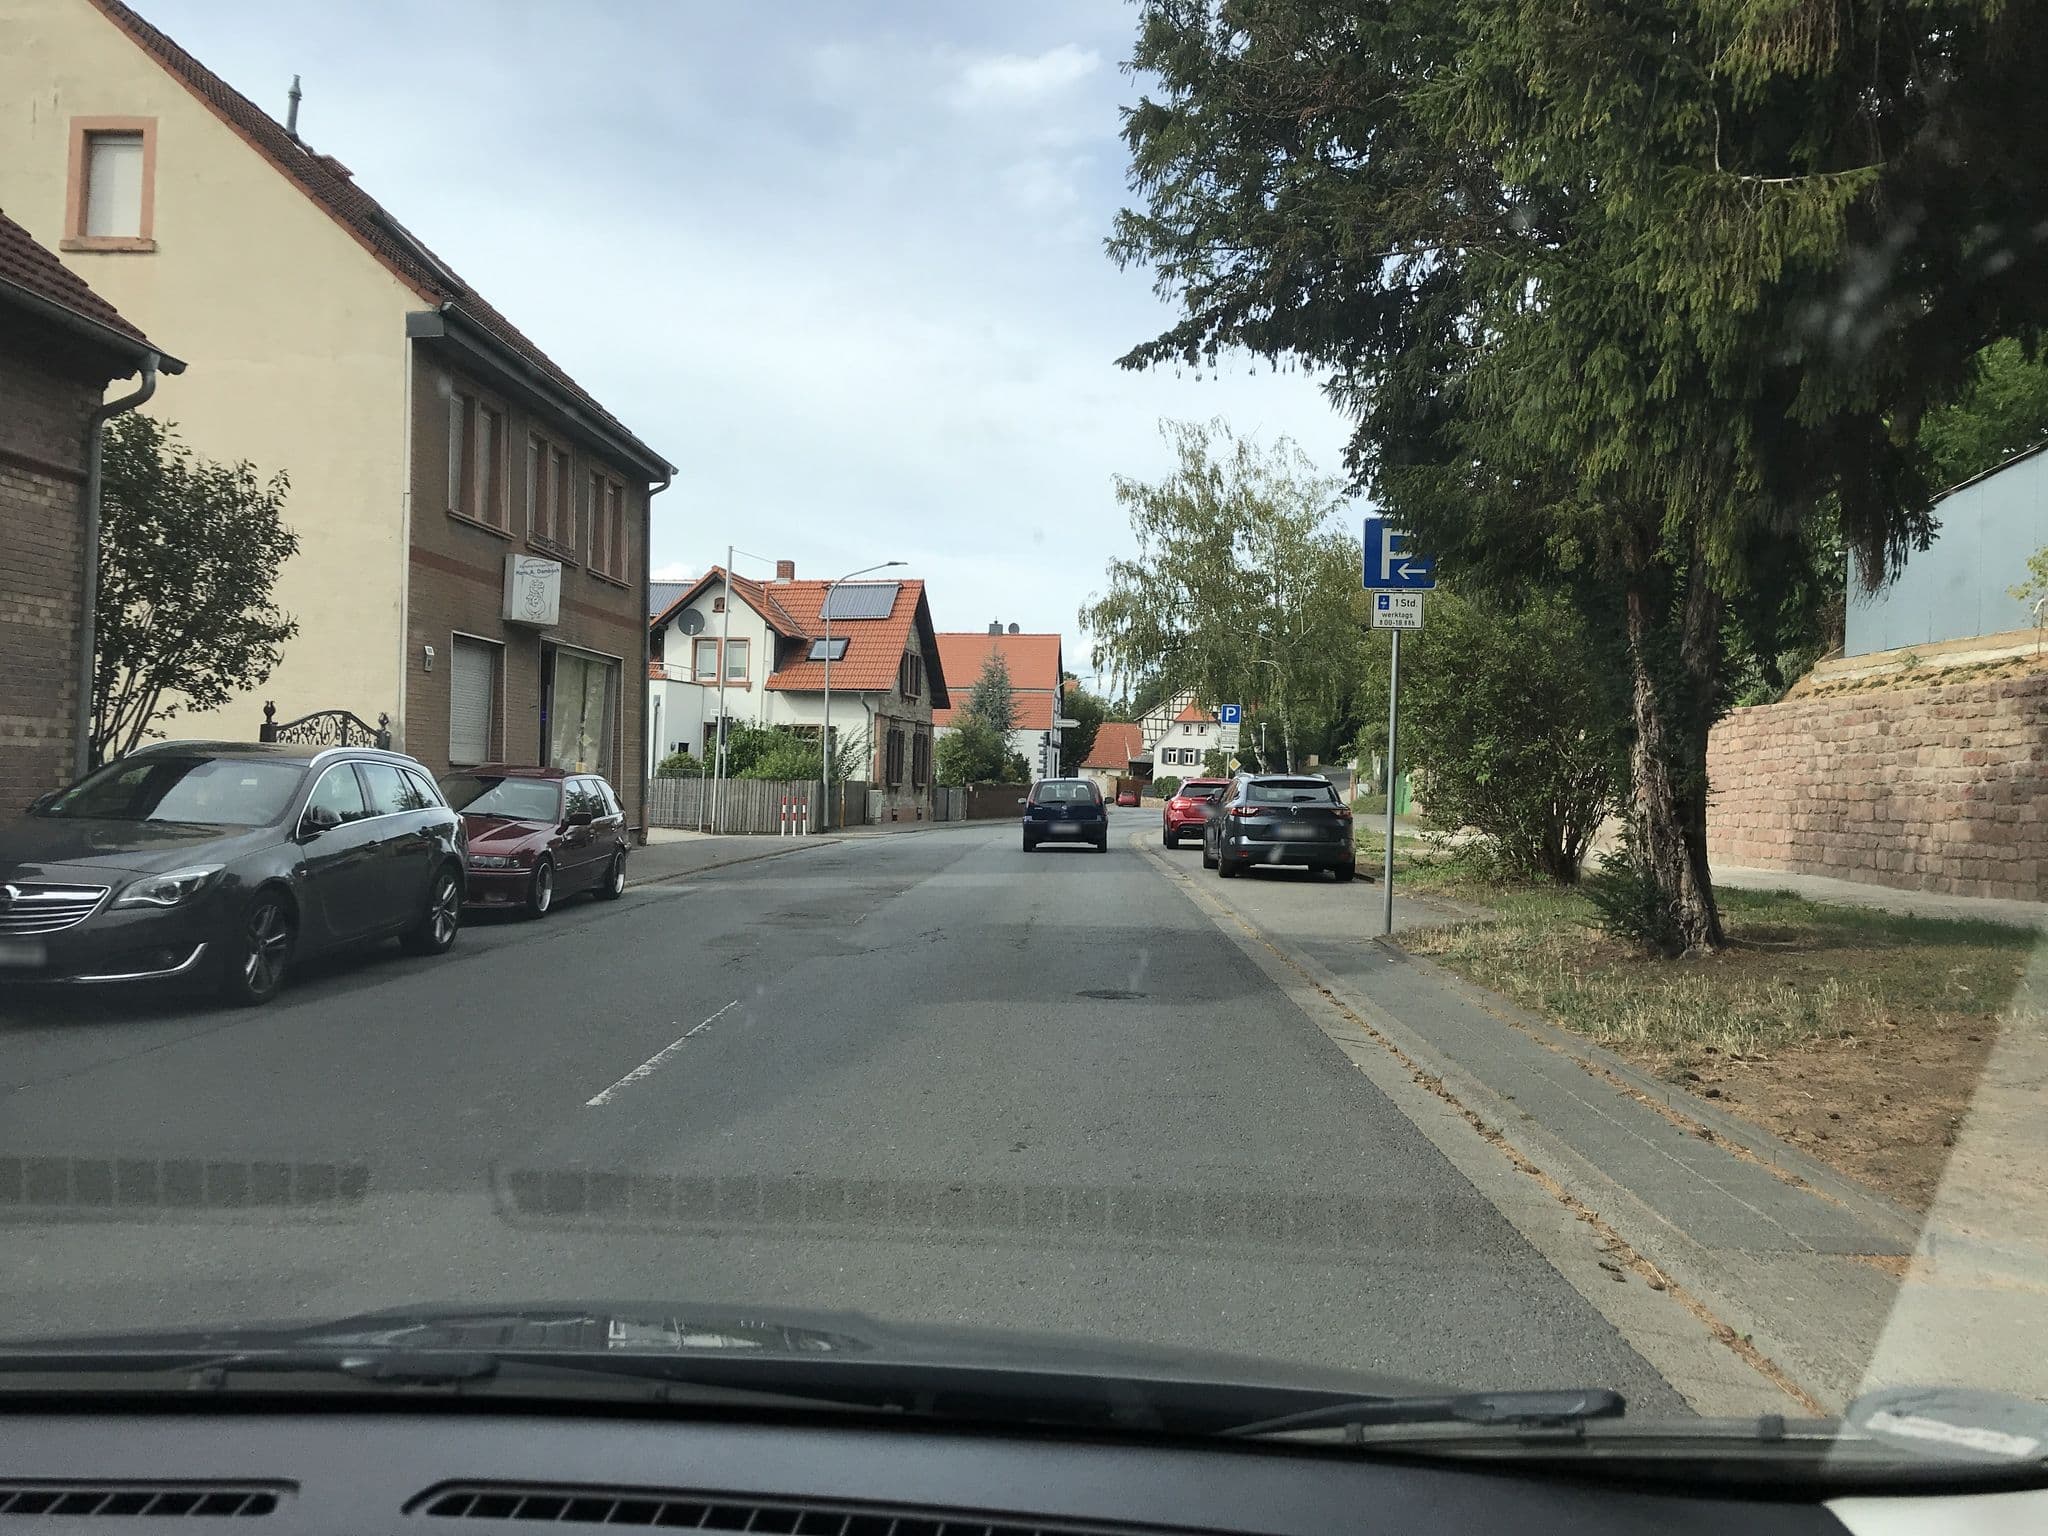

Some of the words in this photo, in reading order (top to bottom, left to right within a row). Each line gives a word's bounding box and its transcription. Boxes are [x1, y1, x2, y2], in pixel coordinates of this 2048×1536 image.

[1401, 598, 1418, 608] Std.
[1382, 611, 1413, 620] werktags
[1226, 707, 1237, 722] P
